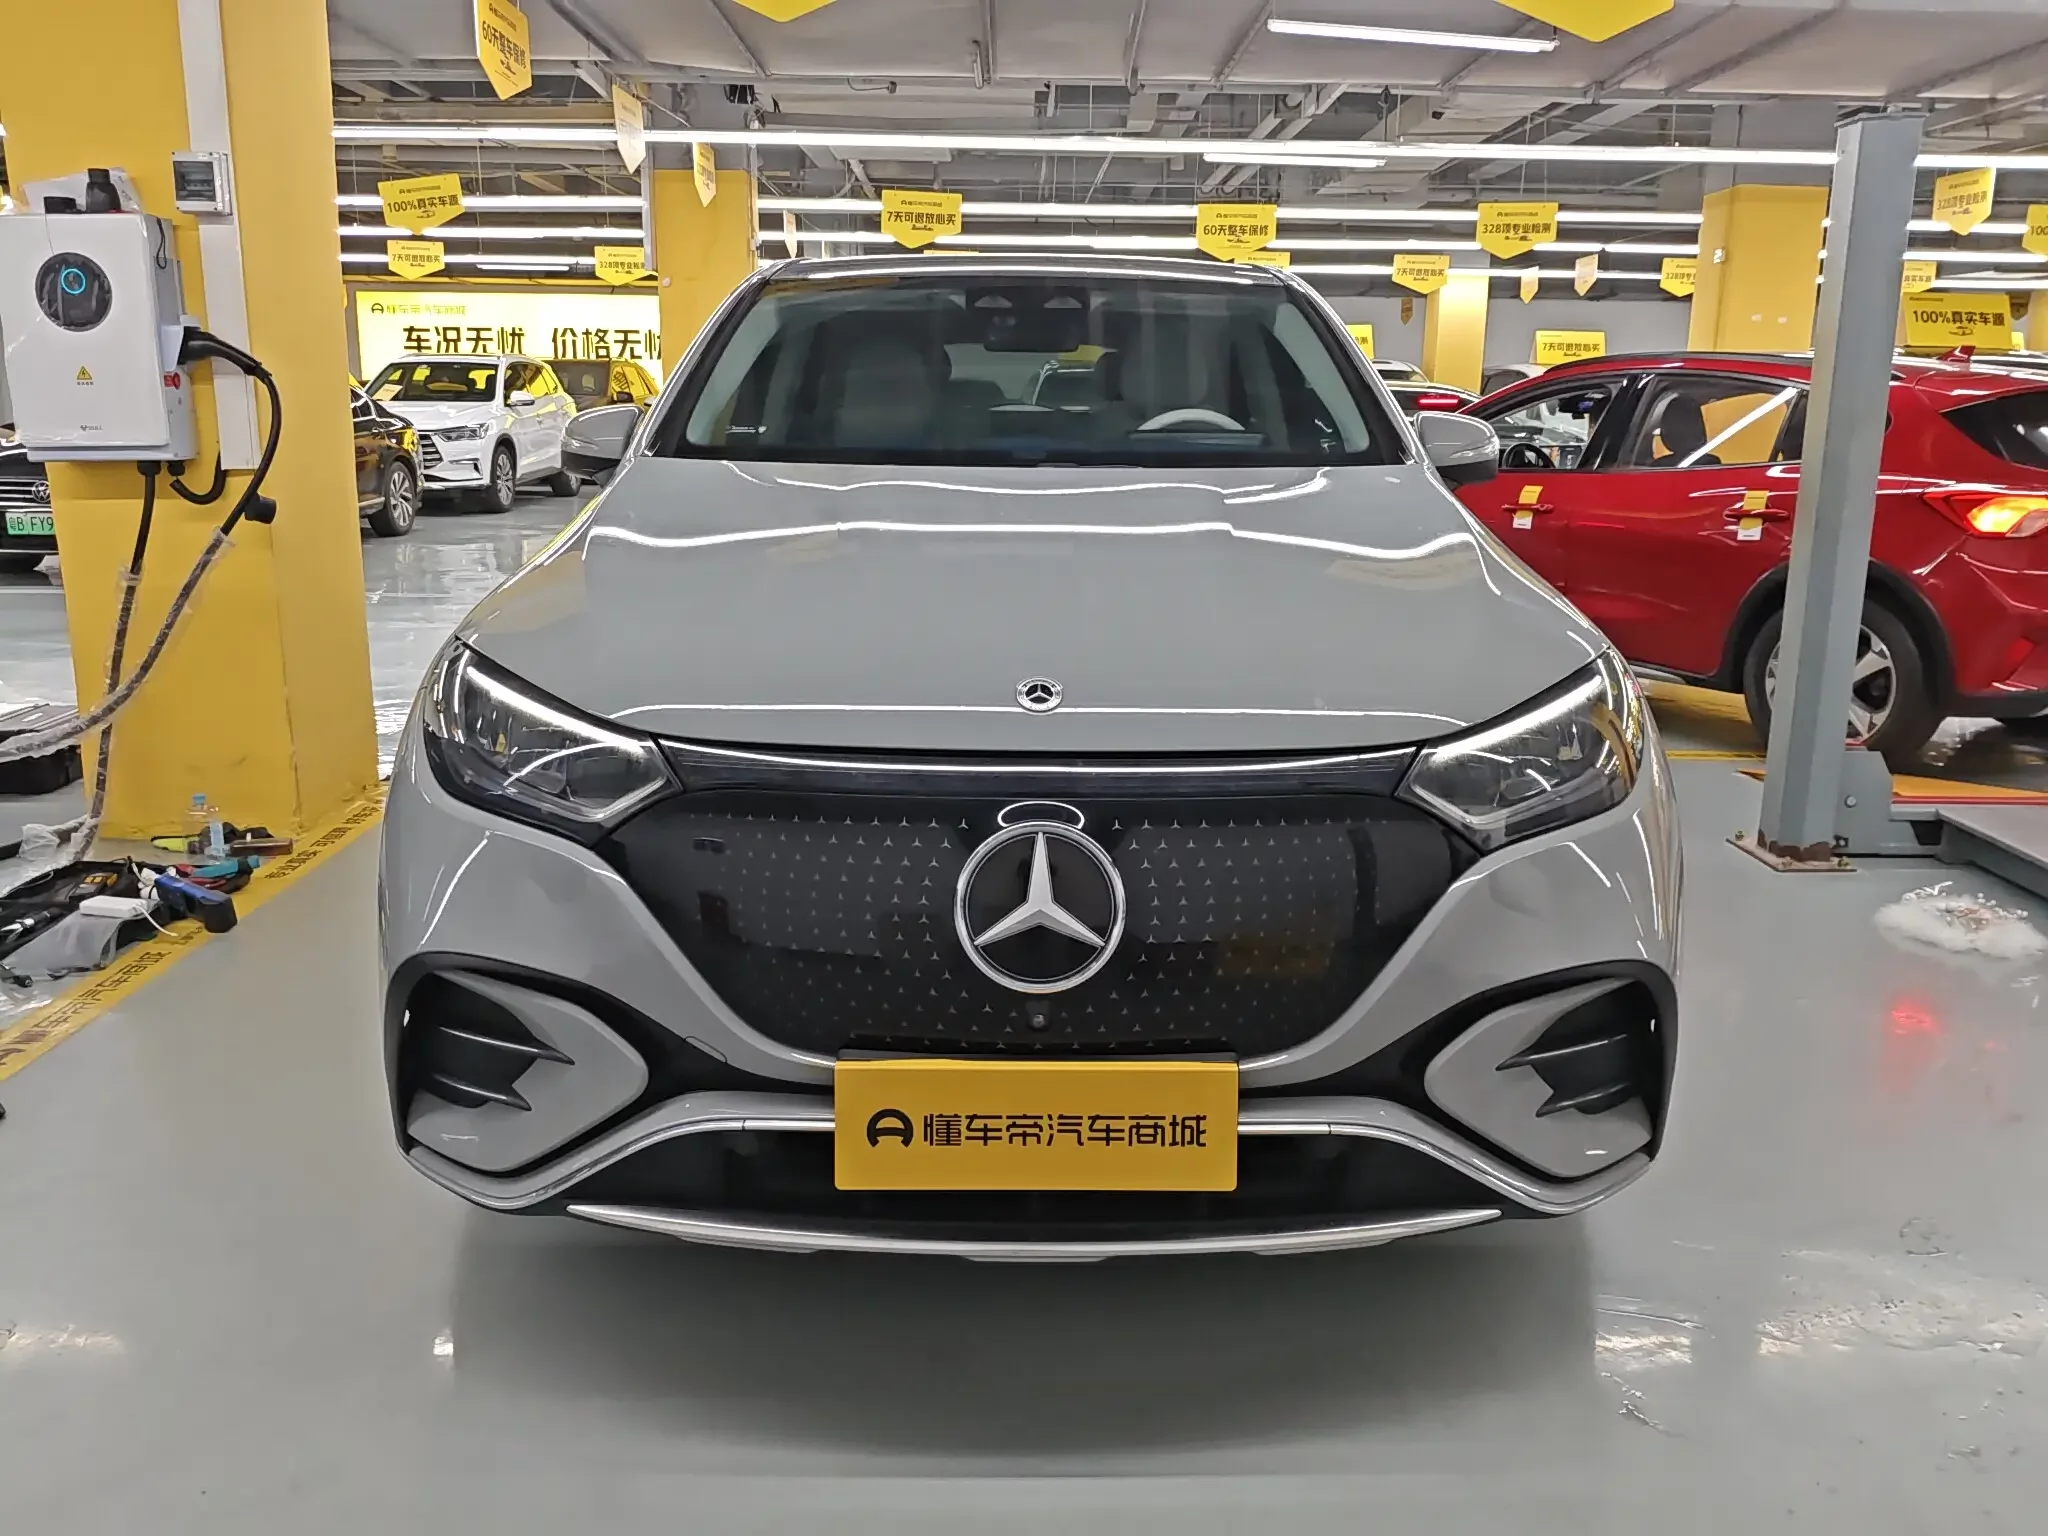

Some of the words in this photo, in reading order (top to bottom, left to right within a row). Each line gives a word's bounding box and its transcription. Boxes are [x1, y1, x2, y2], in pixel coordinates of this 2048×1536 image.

[387, 194, 459, 213] 100%真实车源
[887, 211, 956, 226] 7天可退放心买
[1203, 224, 1269, 237] 60天整车保修
[1482, 223, 1552, 235] 328项专业检测
[1912, 310, 2005, 326] 100%真实车源
[403, 326, 524, 354] 车况无忧
[923, 1113, 1208, 1147] 懂车帝汽车商城
